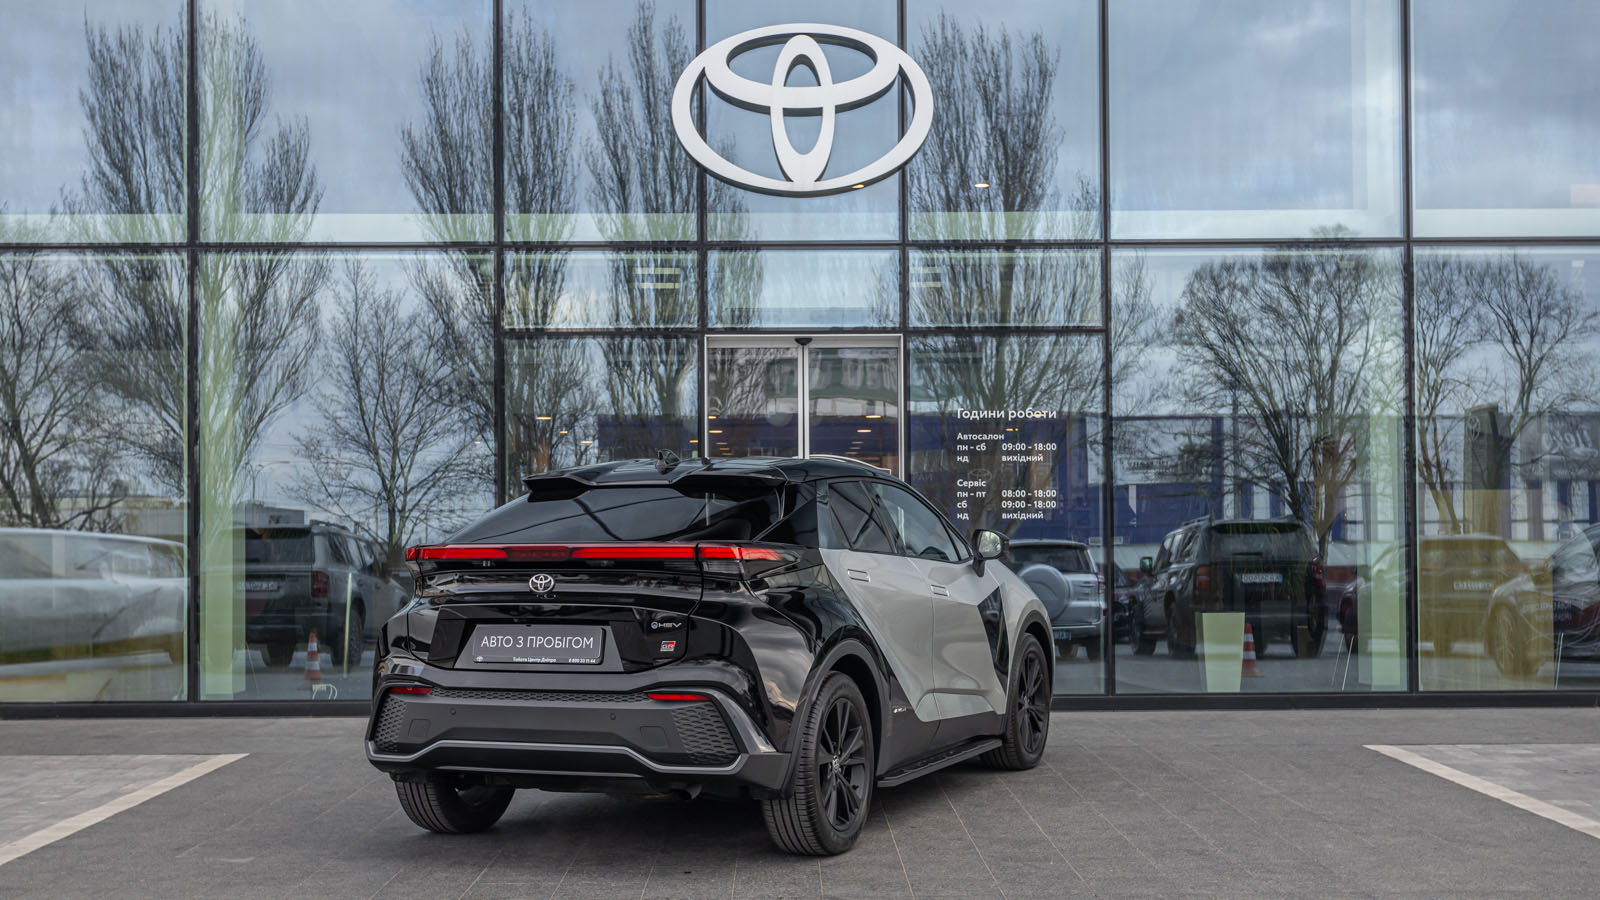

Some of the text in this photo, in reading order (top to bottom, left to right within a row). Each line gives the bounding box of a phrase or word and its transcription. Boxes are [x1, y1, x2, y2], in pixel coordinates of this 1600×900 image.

[957, 407, 1057, 421] Години роботи
[976, 443, 986, 451] сб
[1002, 443, 1026, 451] 09:00
[1034, 443, 1056, 451] 18:00
[1002, 454, 1044, 463] вихідний
[956, 480, 986, 488] Сервіс
[1002, 490, 1026, 498] 08:00
[1034, 490, 1056, 498] 18:00
[1002, 511, 1044, 520] вихідний
[480, 636, 514, 648] АВТО
[526, 636, 594, 648] ПРОБІГОМ
